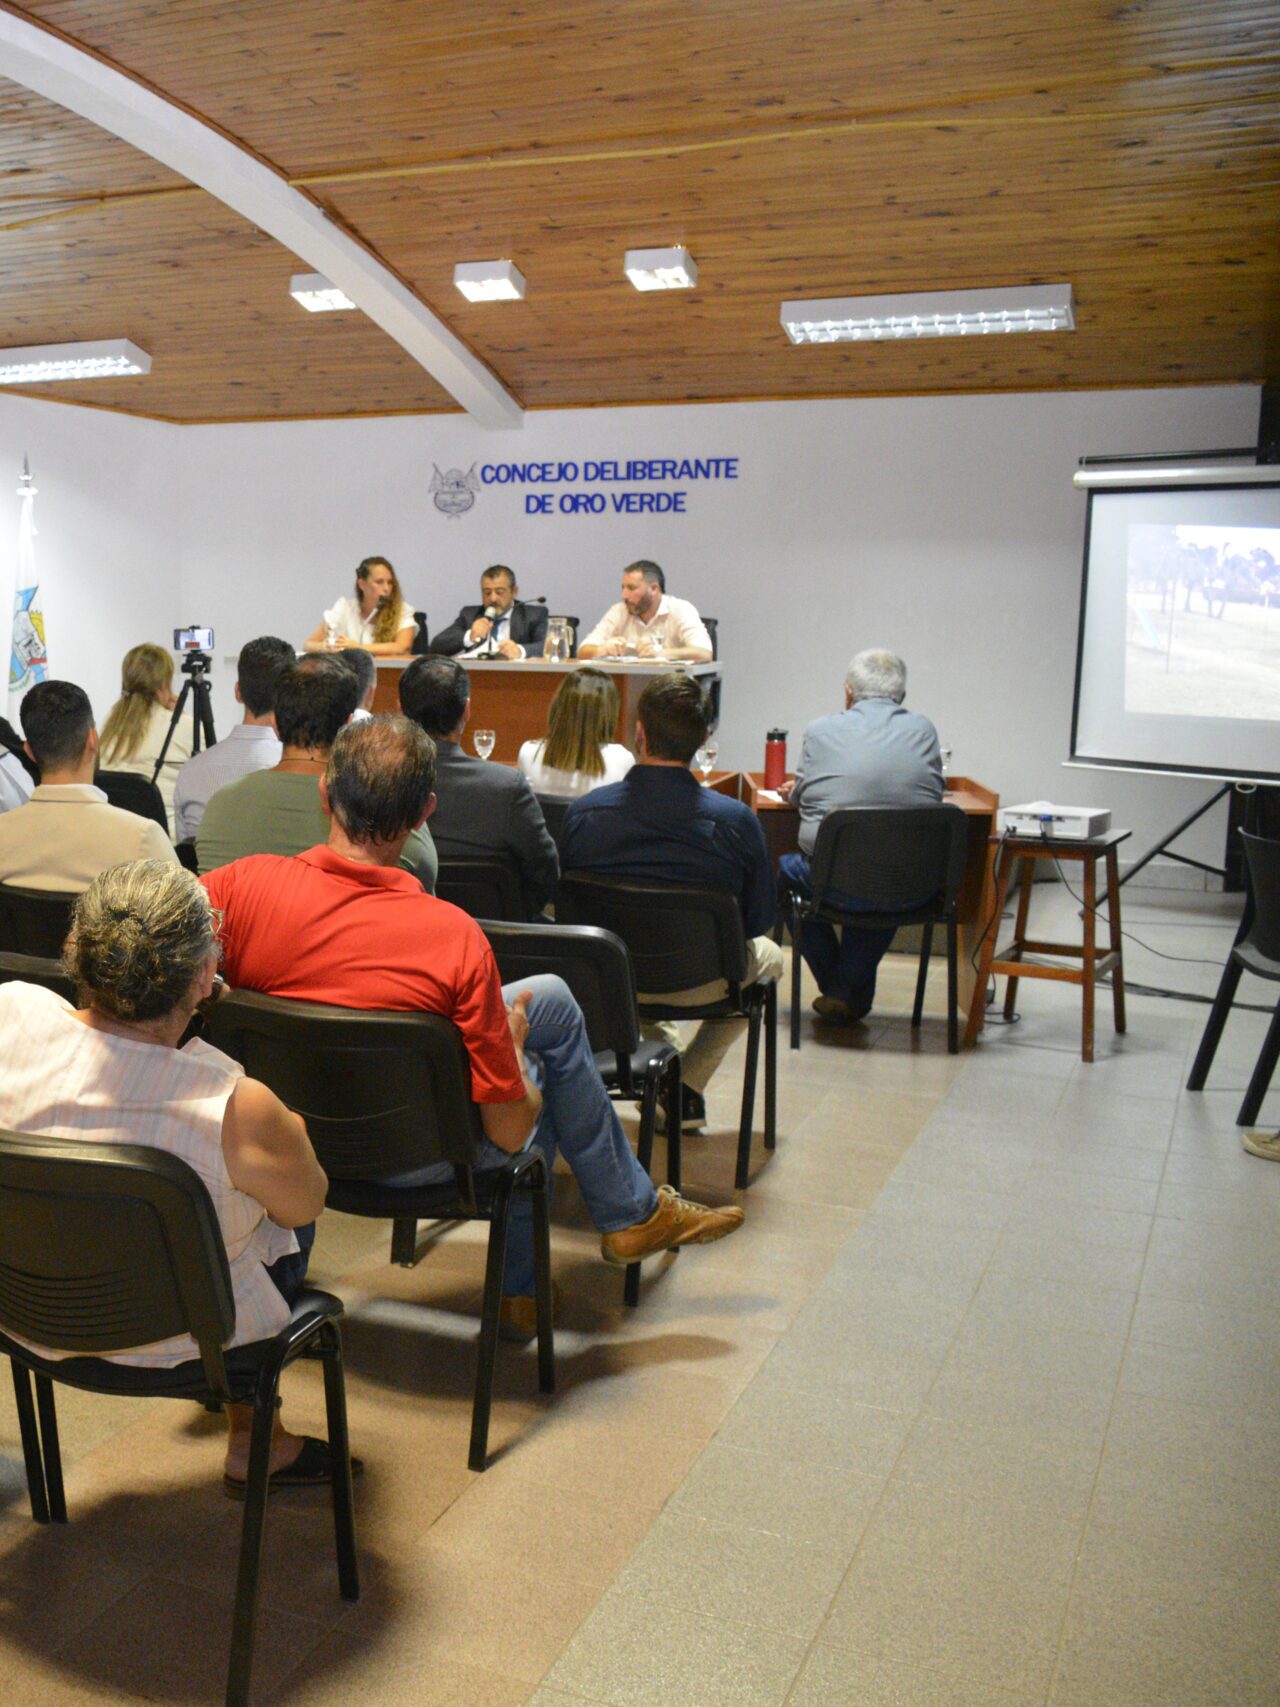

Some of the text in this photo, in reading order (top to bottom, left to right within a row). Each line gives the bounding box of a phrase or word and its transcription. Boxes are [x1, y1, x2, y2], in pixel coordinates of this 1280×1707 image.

[481, 458, 738, 484] CONCEJO DELIBERANTE
[525, 492, 687, 514] DE ORO VERDE
